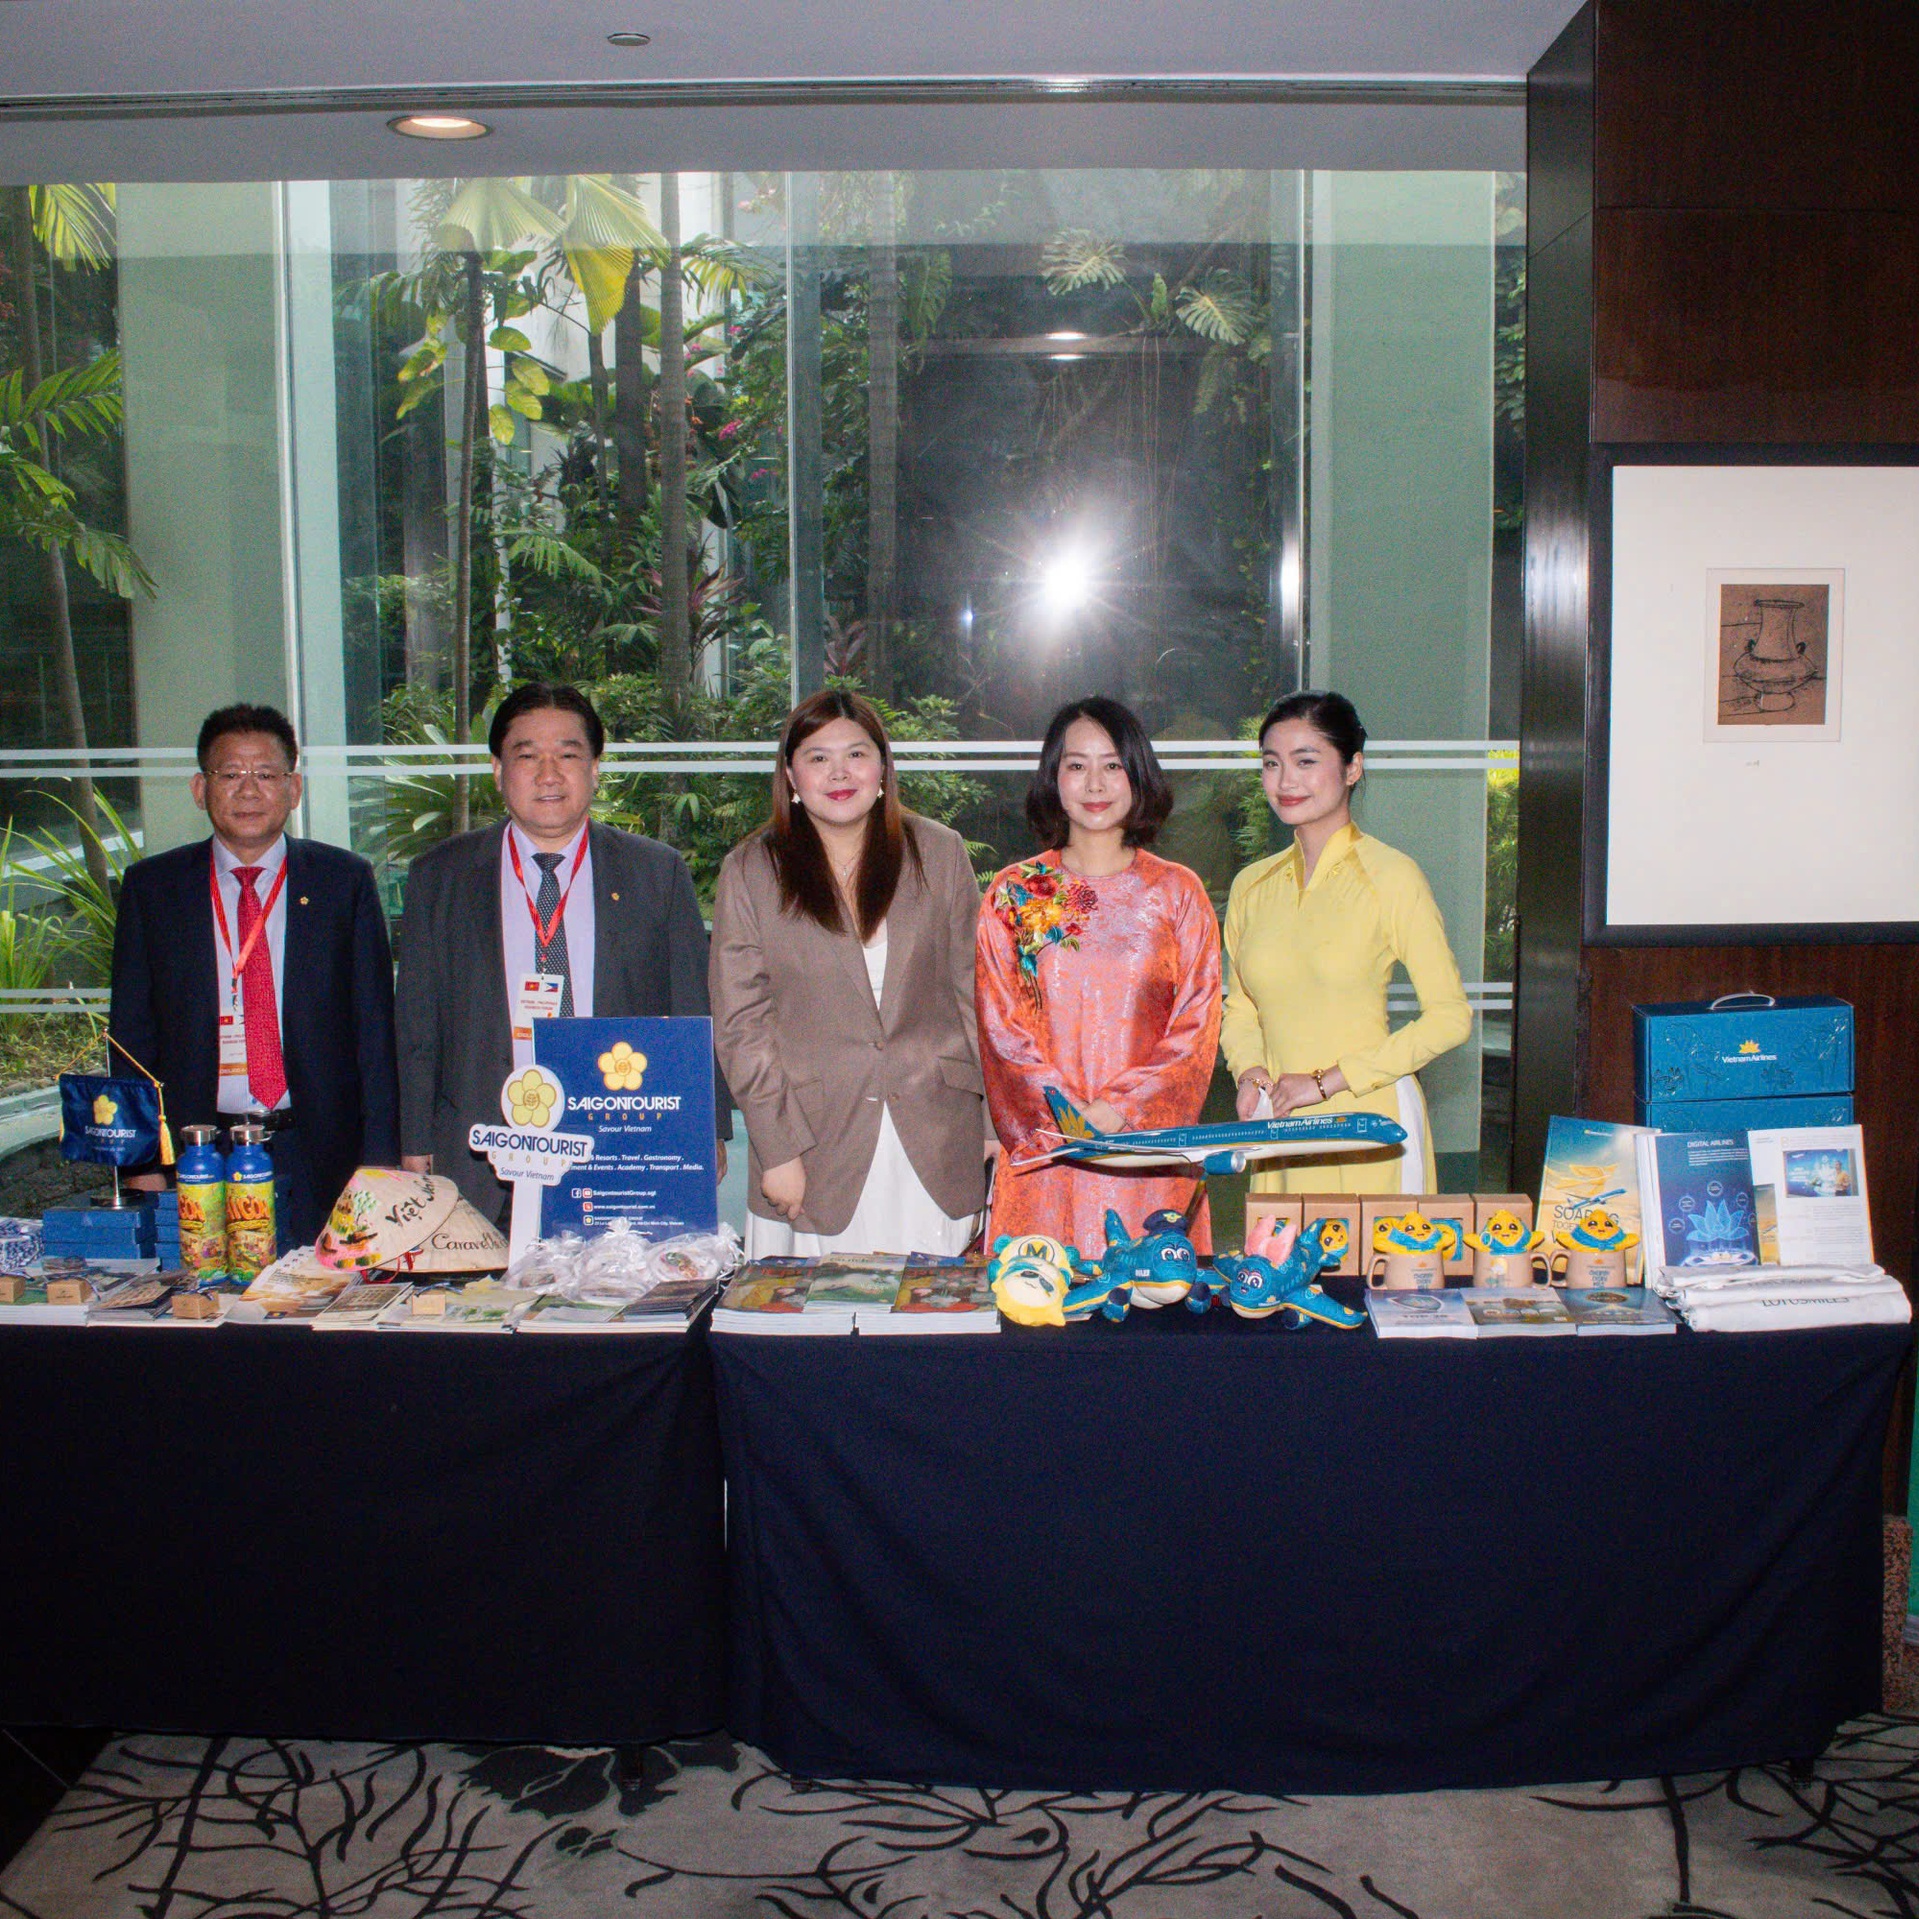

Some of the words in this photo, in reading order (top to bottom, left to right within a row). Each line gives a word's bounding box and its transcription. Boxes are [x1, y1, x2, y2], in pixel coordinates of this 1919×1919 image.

[567, 1096, 681, 1110] SAIGONTOURIST
[588, 1112, 662, 1121] GROUP
[598, 1125, 622, 1133] Savour
[623, 1125, 652, 1133] Vietnam
[472, 1130, 588, 1157] SAIGONTOURIST
[1687, 1141, 1709, 1149] DIGITAL
[492, 1151, 567, 1167] GROUP
[643, 1154, 682, 1163] Gastronomy
[617, 1164, 646, 1172] Academy
[649, 1164, 680, 1172] Transport
[500, 1167, 524, 1178] Savour
[526, 1171, 555, 1181] Vietnam
[1025, 1243, 1048, 1258] M
